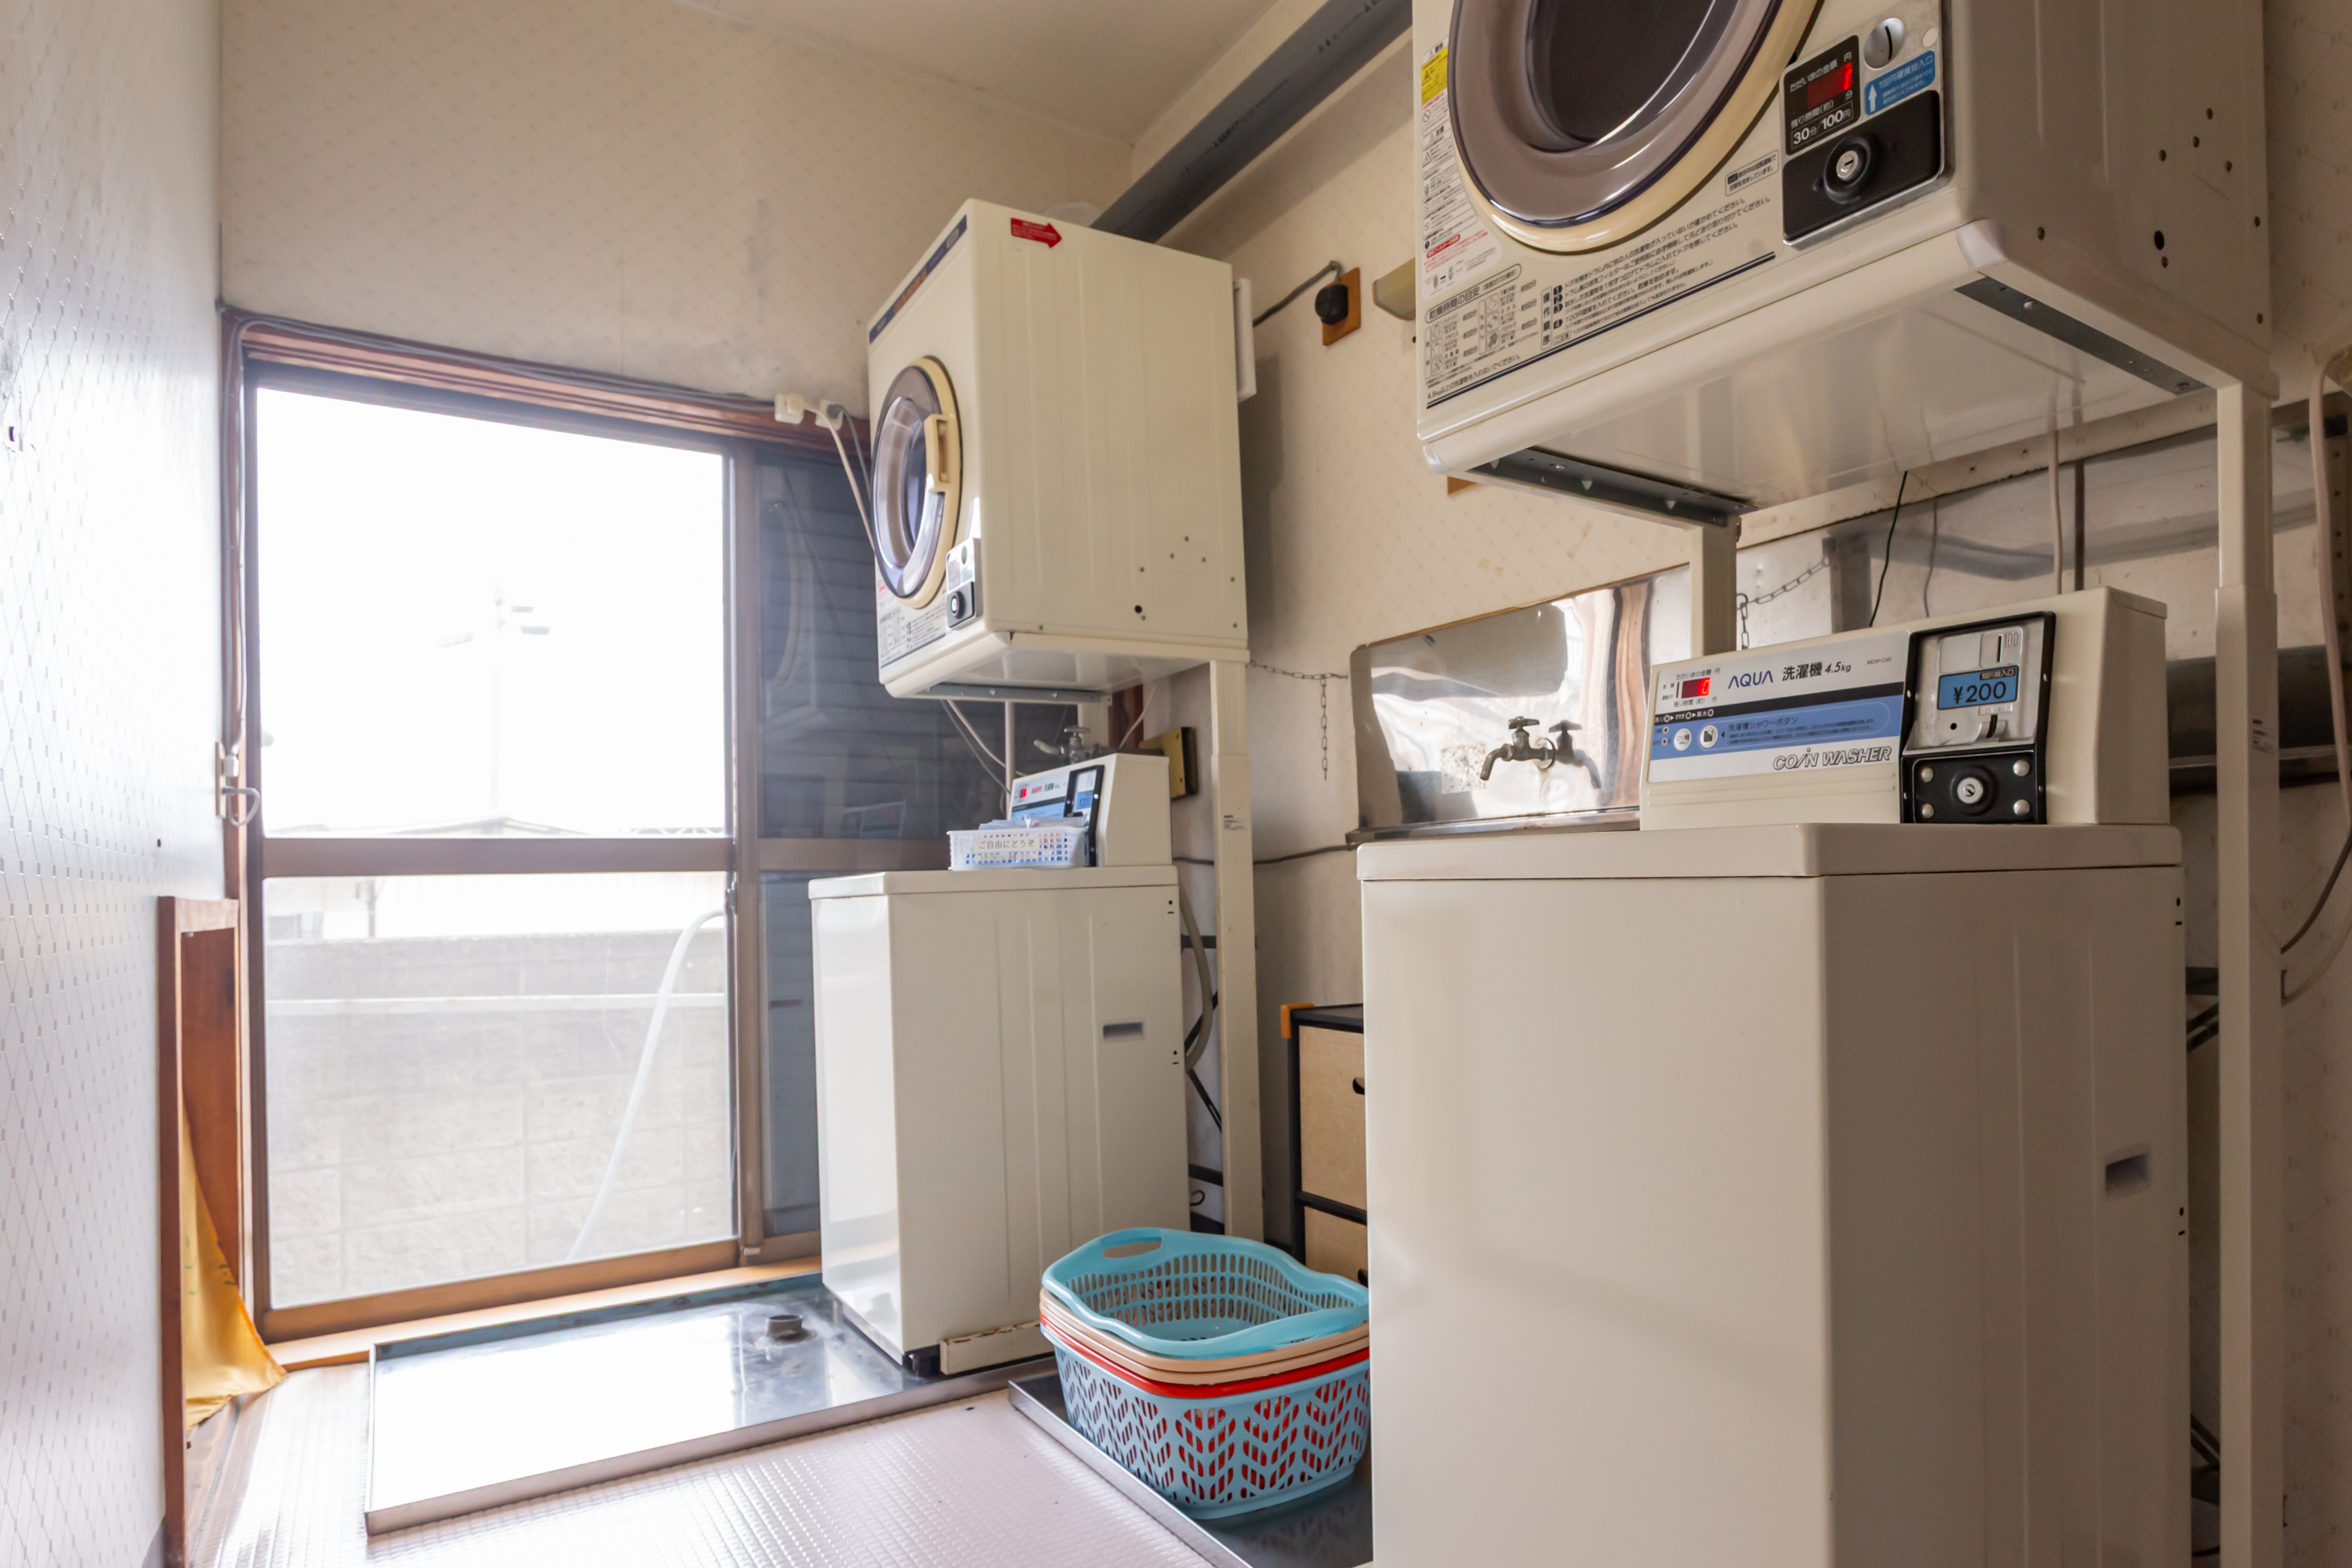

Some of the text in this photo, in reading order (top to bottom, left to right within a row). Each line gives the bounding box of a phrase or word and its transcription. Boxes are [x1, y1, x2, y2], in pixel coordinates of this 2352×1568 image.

[1844, 52, 1851, 63] 円
[1845, 90, 1853, 100] 分
[2005, 632, 2019, 648] 100
[1728, 662, 1851, 690] AQUA 洗濯機 4.5kg
[1701, 679, 1711, 694] 0
[1953, 681, 2006, 705] ¥200
[1773, 746, 1892, 770] COIN WASHER
[979, 839, 1034, 849] ご自由にどうぞ
